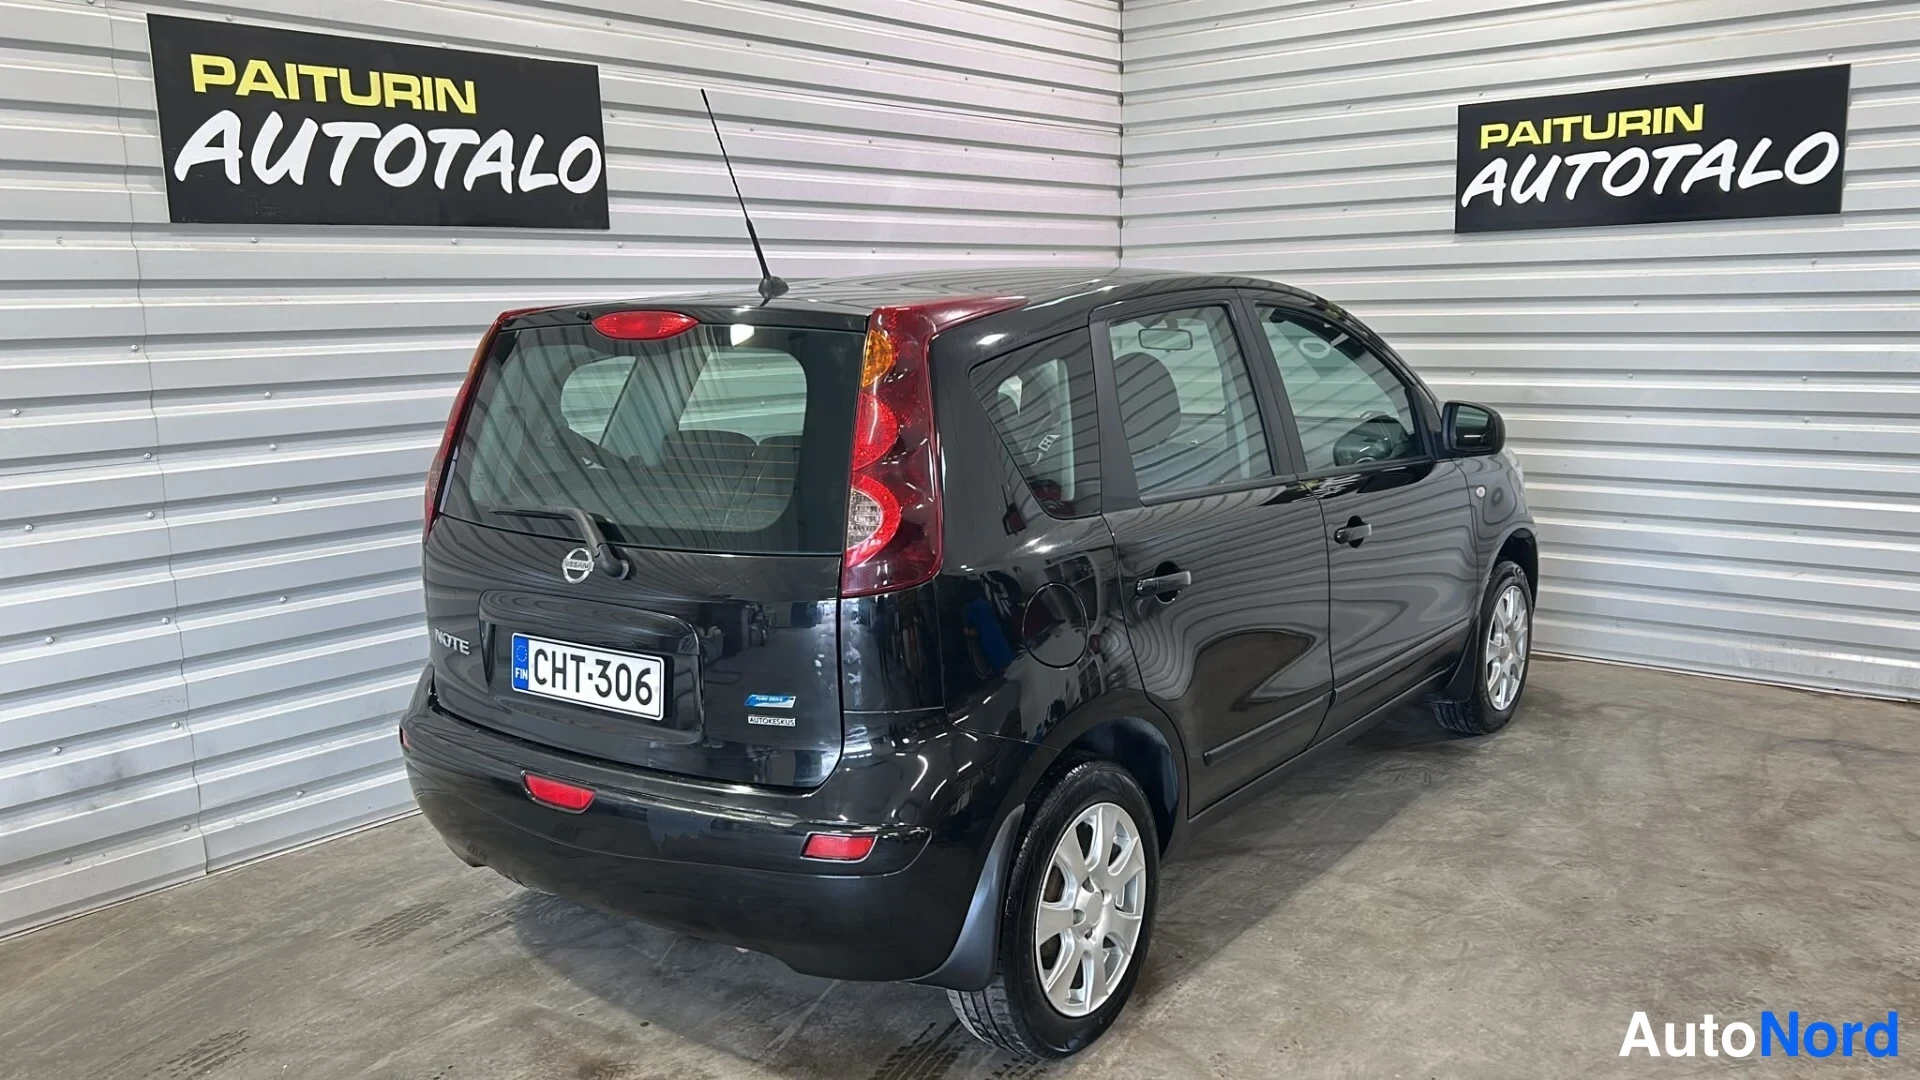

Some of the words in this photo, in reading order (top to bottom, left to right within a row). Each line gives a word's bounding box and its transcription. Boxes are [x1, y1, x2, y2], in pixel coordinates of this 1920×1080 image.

[190, 54, 477, 115] PAITURIN
[1480, 103, 1704, 149] PAITURIN
[174, 109, 602, 194] AUTOTALO
[1461, 131, 1840, 208] AUTOTALO
[565, 560, 589, 569] NISSAN
[435, 628, 470, 656] NOTE
[515, 667, 528, 680] FIN
[750, 717, 795, 725] AUTOKESKUS
